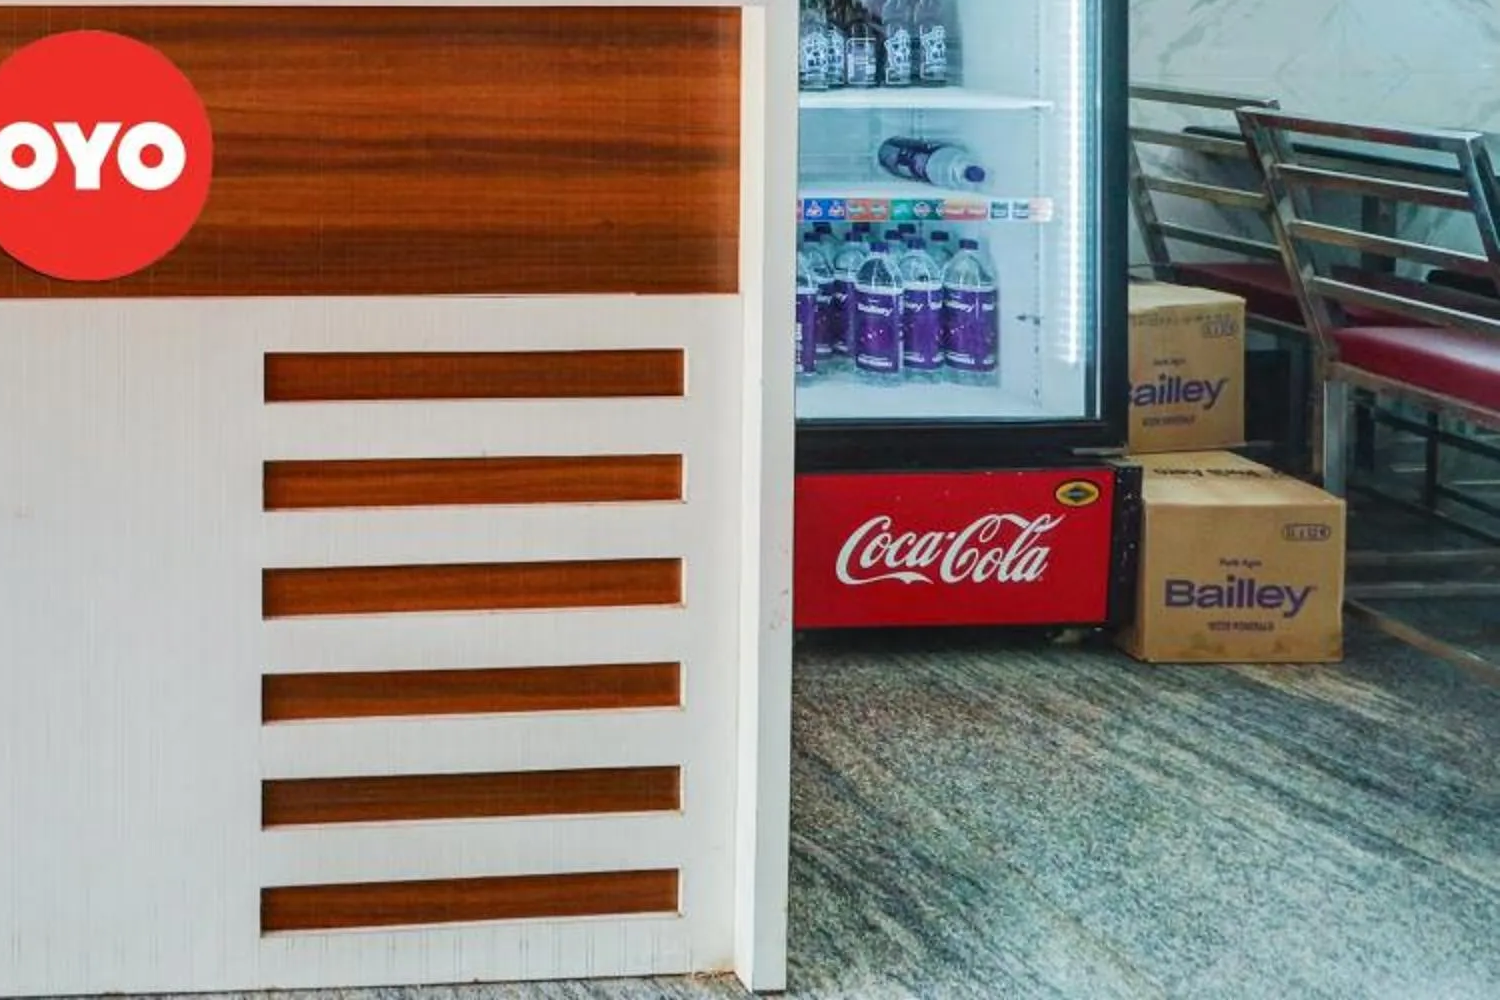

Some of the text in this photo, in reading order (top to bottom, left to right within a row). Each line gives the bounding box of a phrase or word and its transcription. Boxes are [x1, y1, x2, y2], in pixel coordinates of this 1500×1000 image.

[1129, 373, 1224, 411] ailley
[835, 513, 1066, 585] Coca-Cola
[1164, 574, 1311, 619] Bailley
